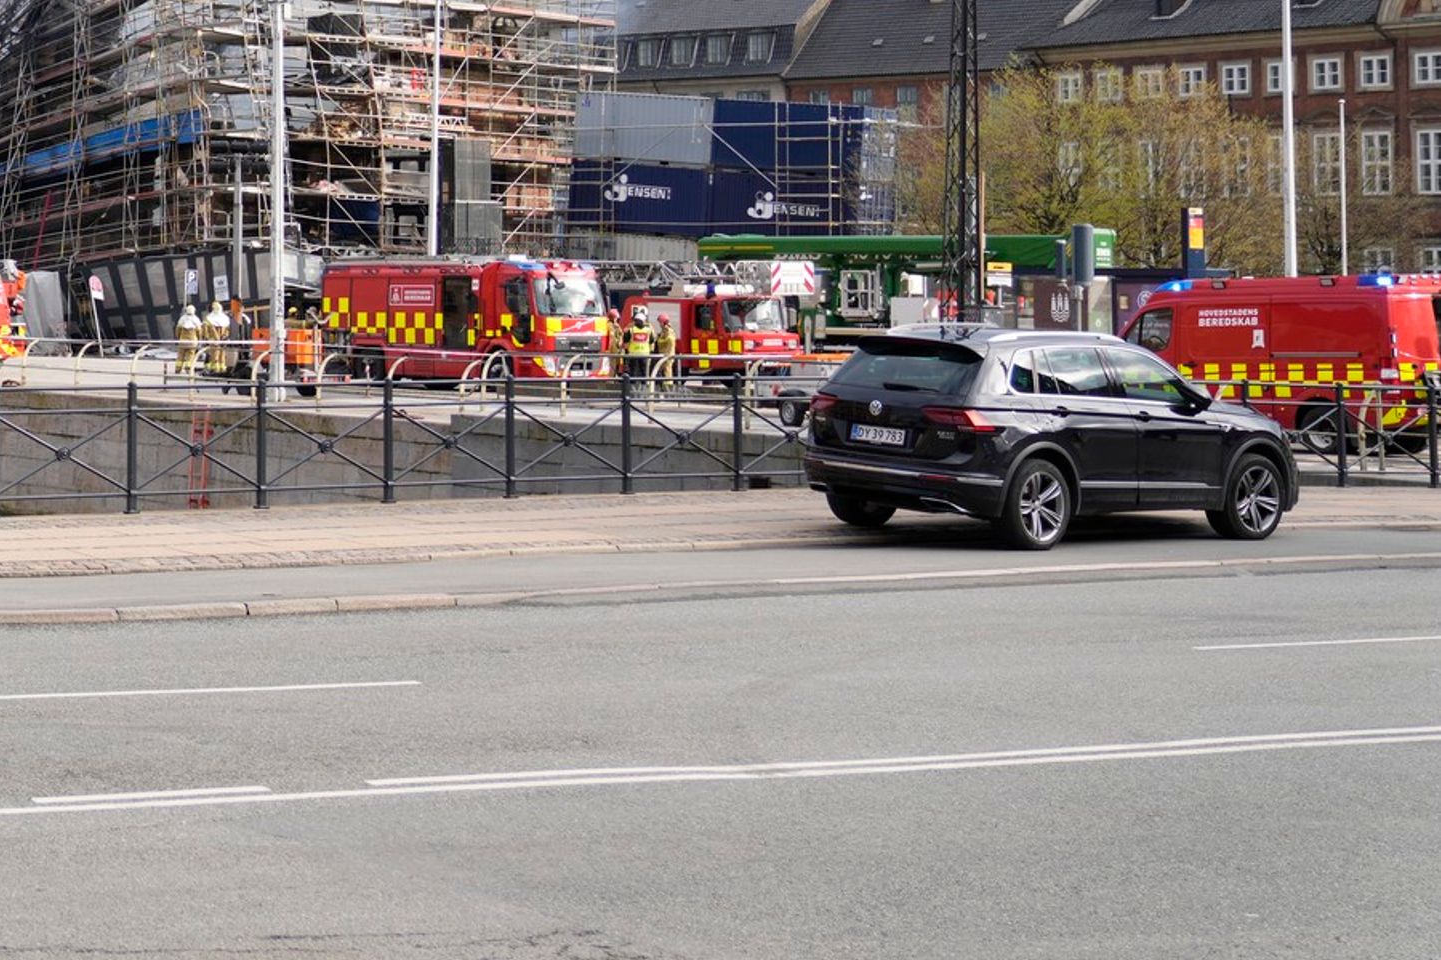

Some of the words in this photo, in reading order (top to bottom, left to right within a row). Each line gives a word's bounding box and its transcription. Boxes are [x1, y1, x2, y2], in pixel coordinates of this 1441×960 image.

[1198, 308, 1259, 317] HOVEDSTADENS
[1198, 316, 1259, 327] BEREDSKAB
[858, 426, 871, 438] DY
[871, 428, 884, 439] 39
[885, 430, 903, 443] 783
